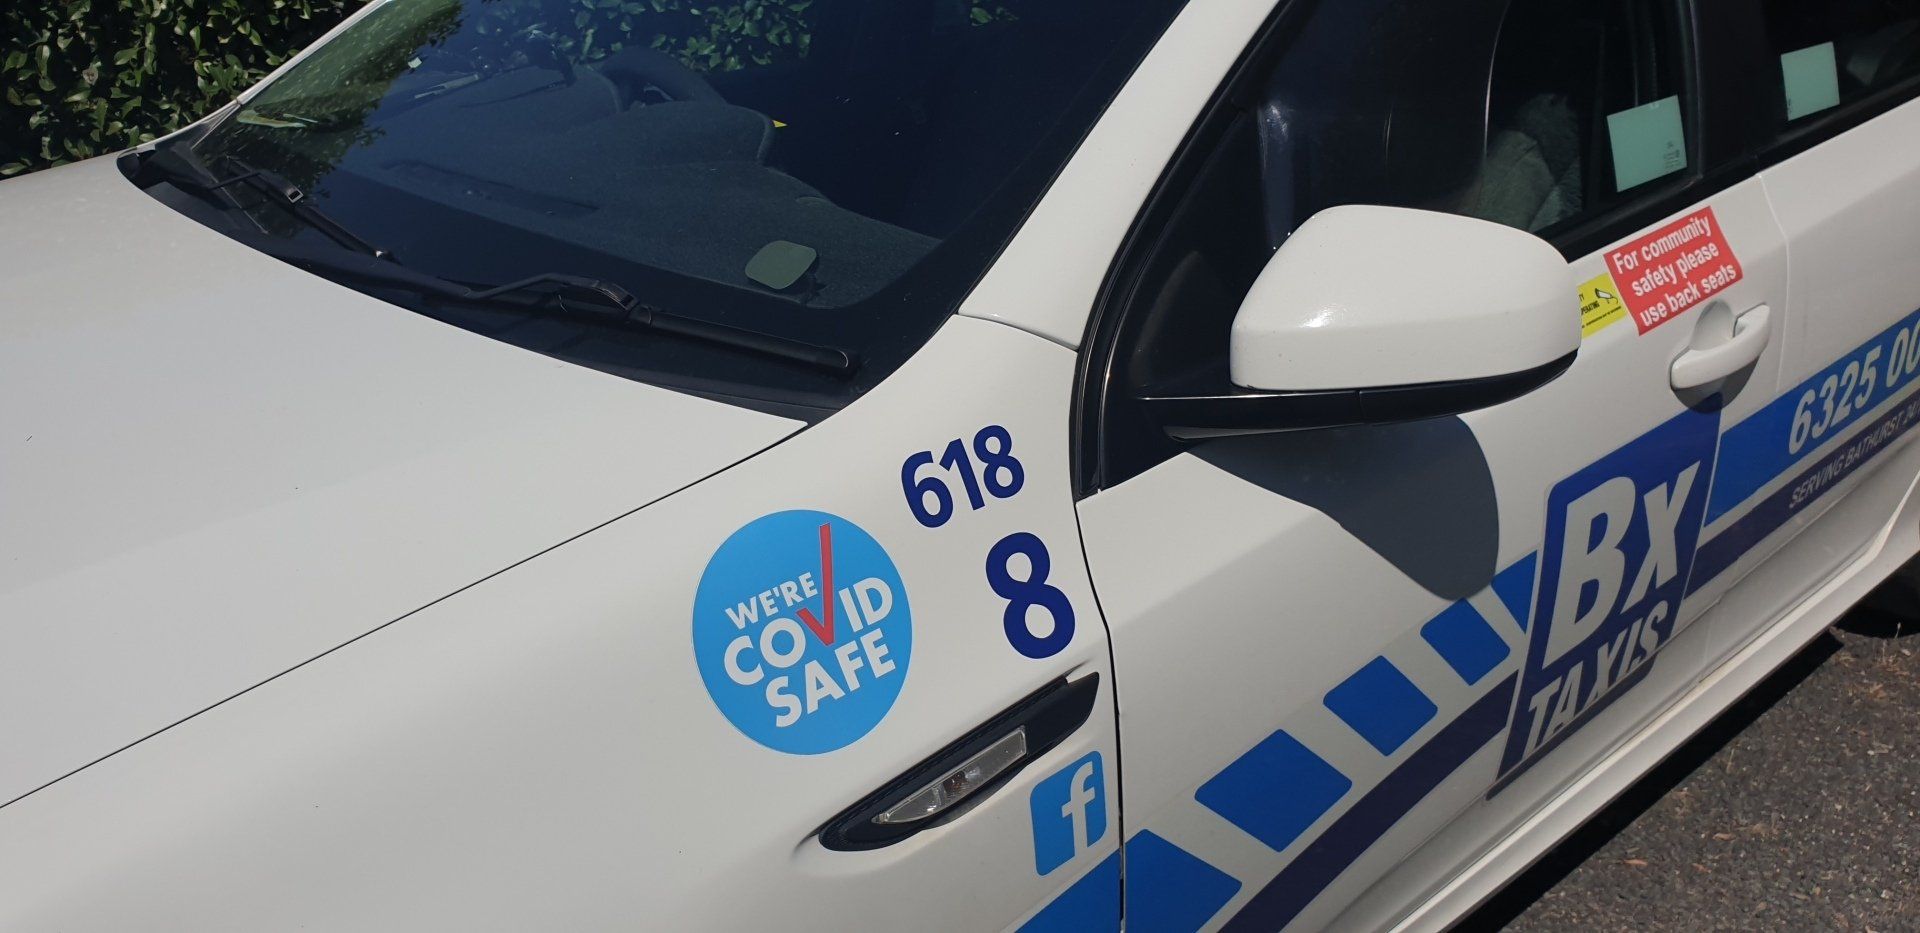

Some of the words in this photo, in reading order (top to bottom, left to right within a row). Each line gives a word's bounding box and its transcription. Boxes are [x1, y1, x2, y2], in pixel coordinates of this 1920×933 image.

[1613, 252, 1638, 274] For
[1641, 215, 1712, 261] community
[1631, 262, 1678, 296] safety
[1676, 242, 1720, 278] please
[1581, 300, 1600, 315] PERATING
[1639, 304, 1667, 327] use
[1664, 281, 1700, 313] back
[1701, 264, 1737, 294] seats
[1788, 345, 1882, 455] 6325
[901, 425, 1025, 528] 618
[1788, 453, 1845, 509] SERVING
[1844, 411, 1902, 468] BATHURST
[723, 573, 894, 687] COVID
[725, 571, 817, 631] WE'RE
[985, 532, 1075, 659] 8
[765, 628, 896, 728] SAFE
[1521, 599, 1669, 761] TAXIS
